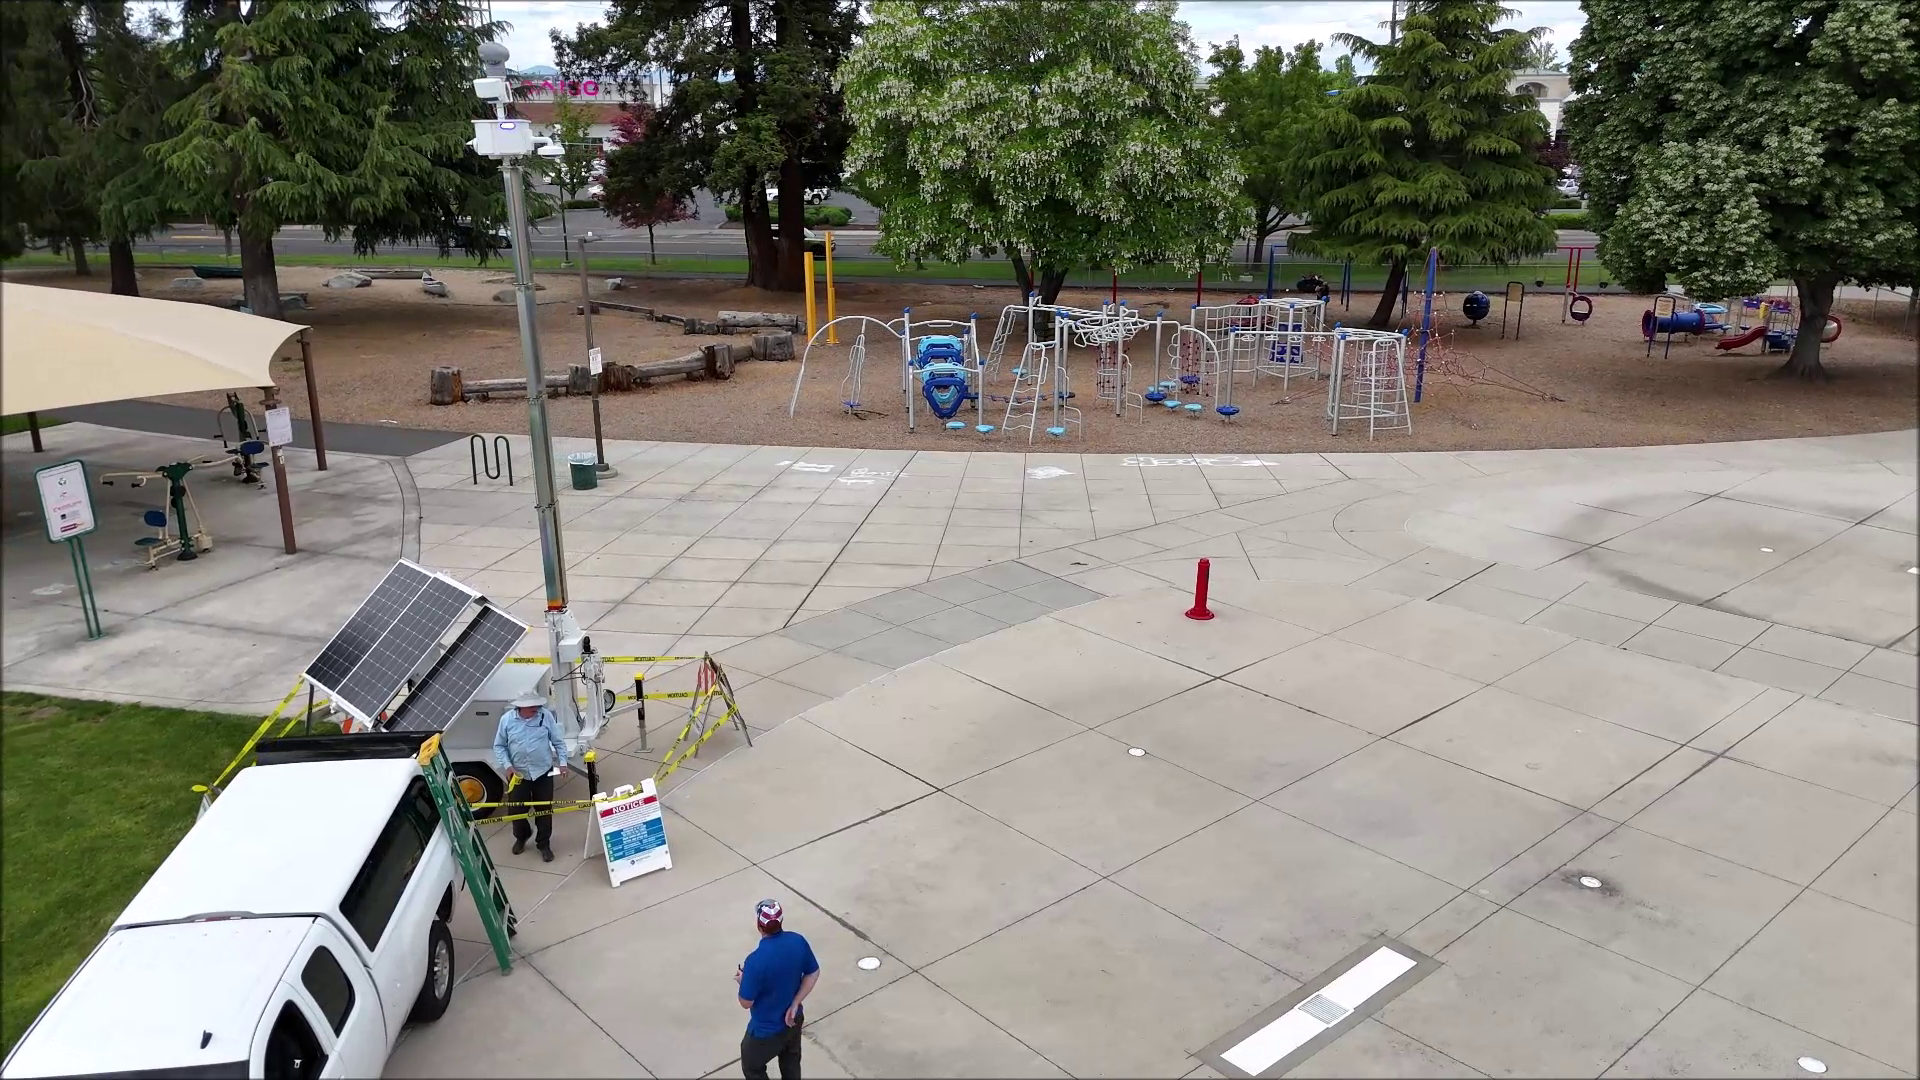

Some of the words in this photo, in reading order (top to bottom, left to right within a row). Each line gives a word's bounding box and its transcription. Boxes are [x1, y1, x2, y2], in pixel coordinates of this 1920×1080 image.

[612, 799, 645, 815] NOTICE
[476, 815, 503, 826] CAUTION
[527, 809, 554, 818] CAUTION
